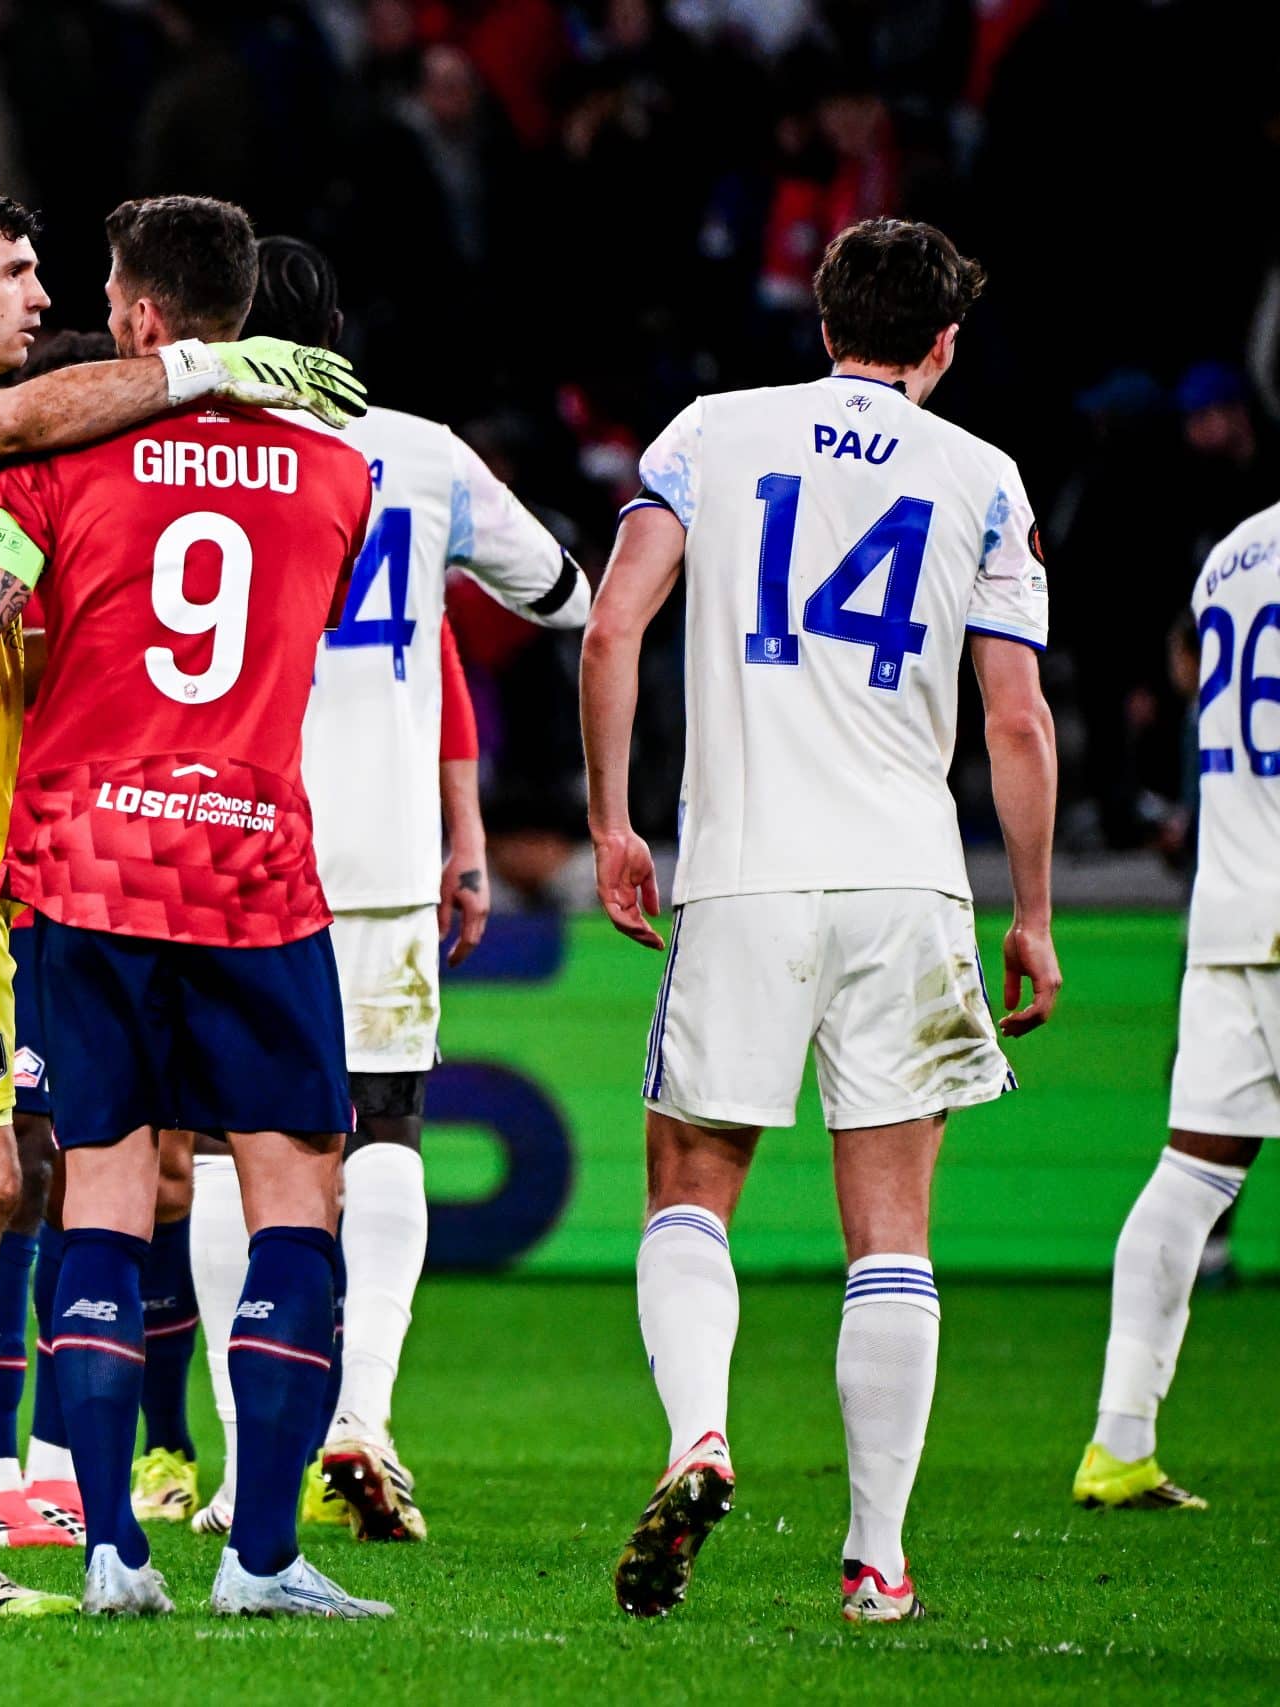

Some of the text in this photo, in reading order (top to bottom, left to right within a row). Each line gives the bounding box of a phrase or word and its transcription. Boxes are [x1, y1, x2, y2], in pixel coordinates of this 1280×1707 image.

[133, 438, 298, 495] GIROUD
[814, 423, 899, 465] PAU
[145, 511, 253, 704] 9
[312, 507, 417, 682] 4
[745, 472, 934, 691] 14
[1199, 603, 1280, 776] 26
[96, 782, 188, 819] LOSC
[195, 810, 275, 833] DOTATION
[256, 802, 276, 818] DE
